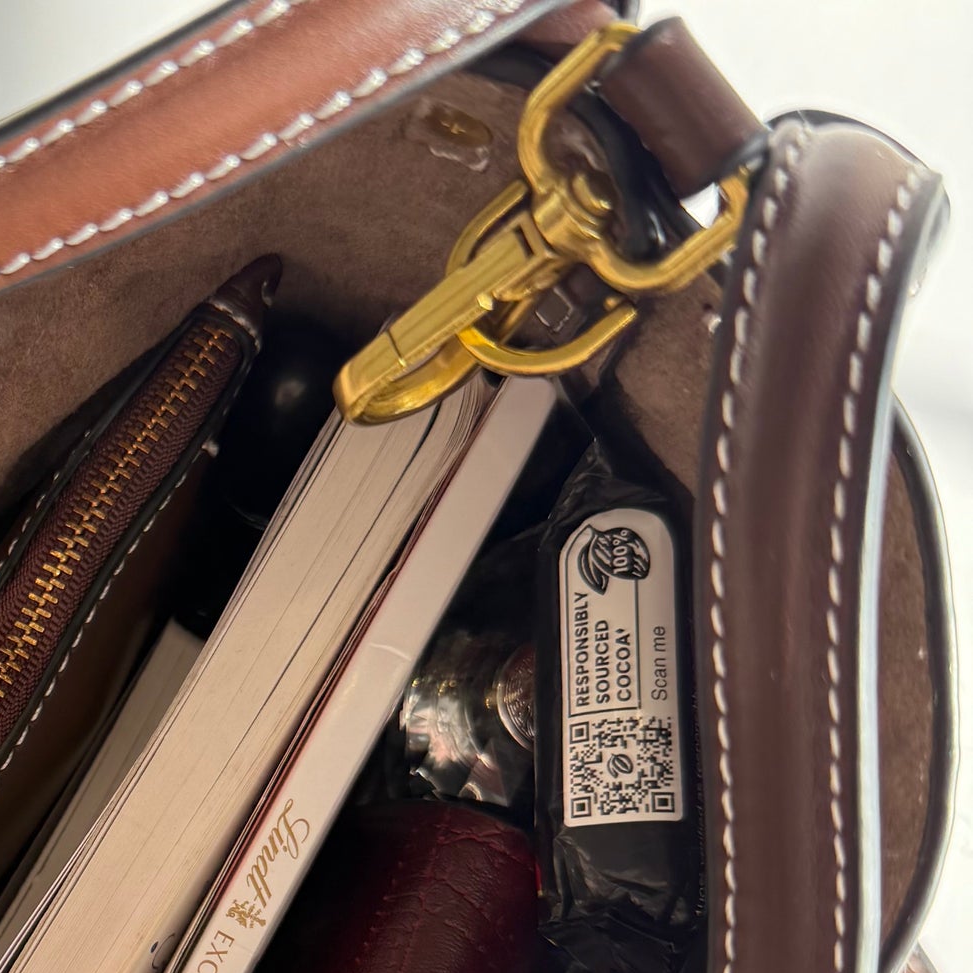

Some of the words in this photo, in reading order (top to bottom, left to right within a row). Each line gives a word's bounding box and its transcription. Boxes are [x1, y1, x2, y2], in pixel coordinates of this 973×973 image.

[613, 530, 629, 574] 100%
[574, 592, 589, 707] RESPONSIBLY
[594, 620, 610, 704] SOURCED
[653, 625, 667, 651] me
[651, 656, 668, 701] Scan
[247, 798, 311, 908] Lindt
